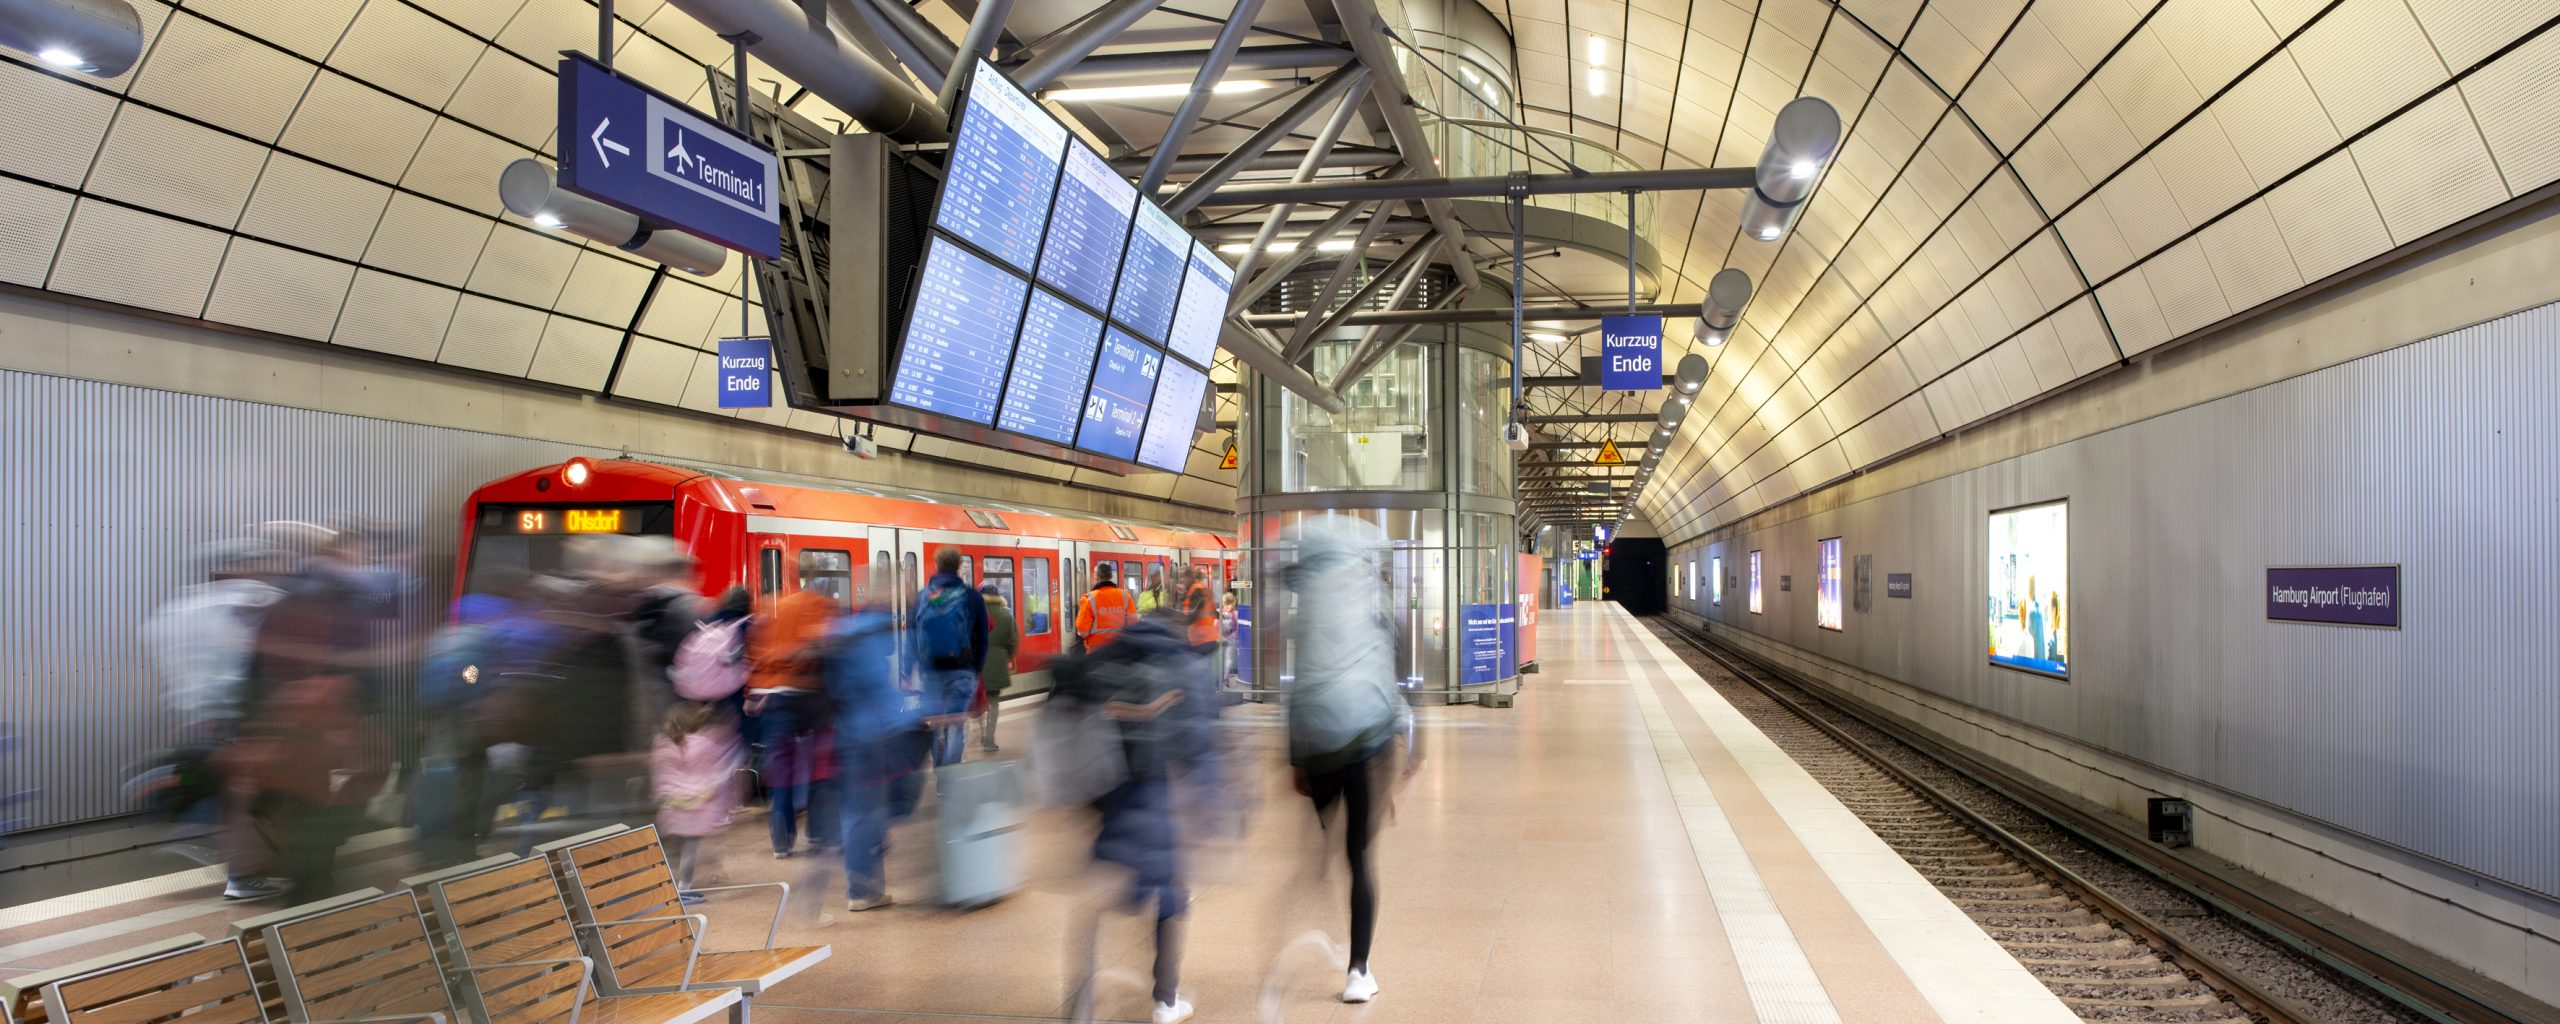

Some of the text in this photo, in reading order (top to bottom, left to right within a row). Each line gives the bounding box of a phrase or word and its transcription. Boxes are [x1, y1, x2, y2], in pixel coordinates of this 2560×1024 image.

[696, 155, 763, 205] Terminal 1
[1113, 338, 1136, 362] Terminal
[1606, 334, 1657, 350] Kurzzug
[722, 356, 765, 371] Kurzzug
[1613, 355, 1652, 372] Ende
[728, 375, 760, 392] Ende
[1111, 402, 1134, 424] Terminal
[523, 510, 620, 531] S1 Ohlsdorf
[2272, 584, 2390, 610] Hamburg Airport (Flughafen)
